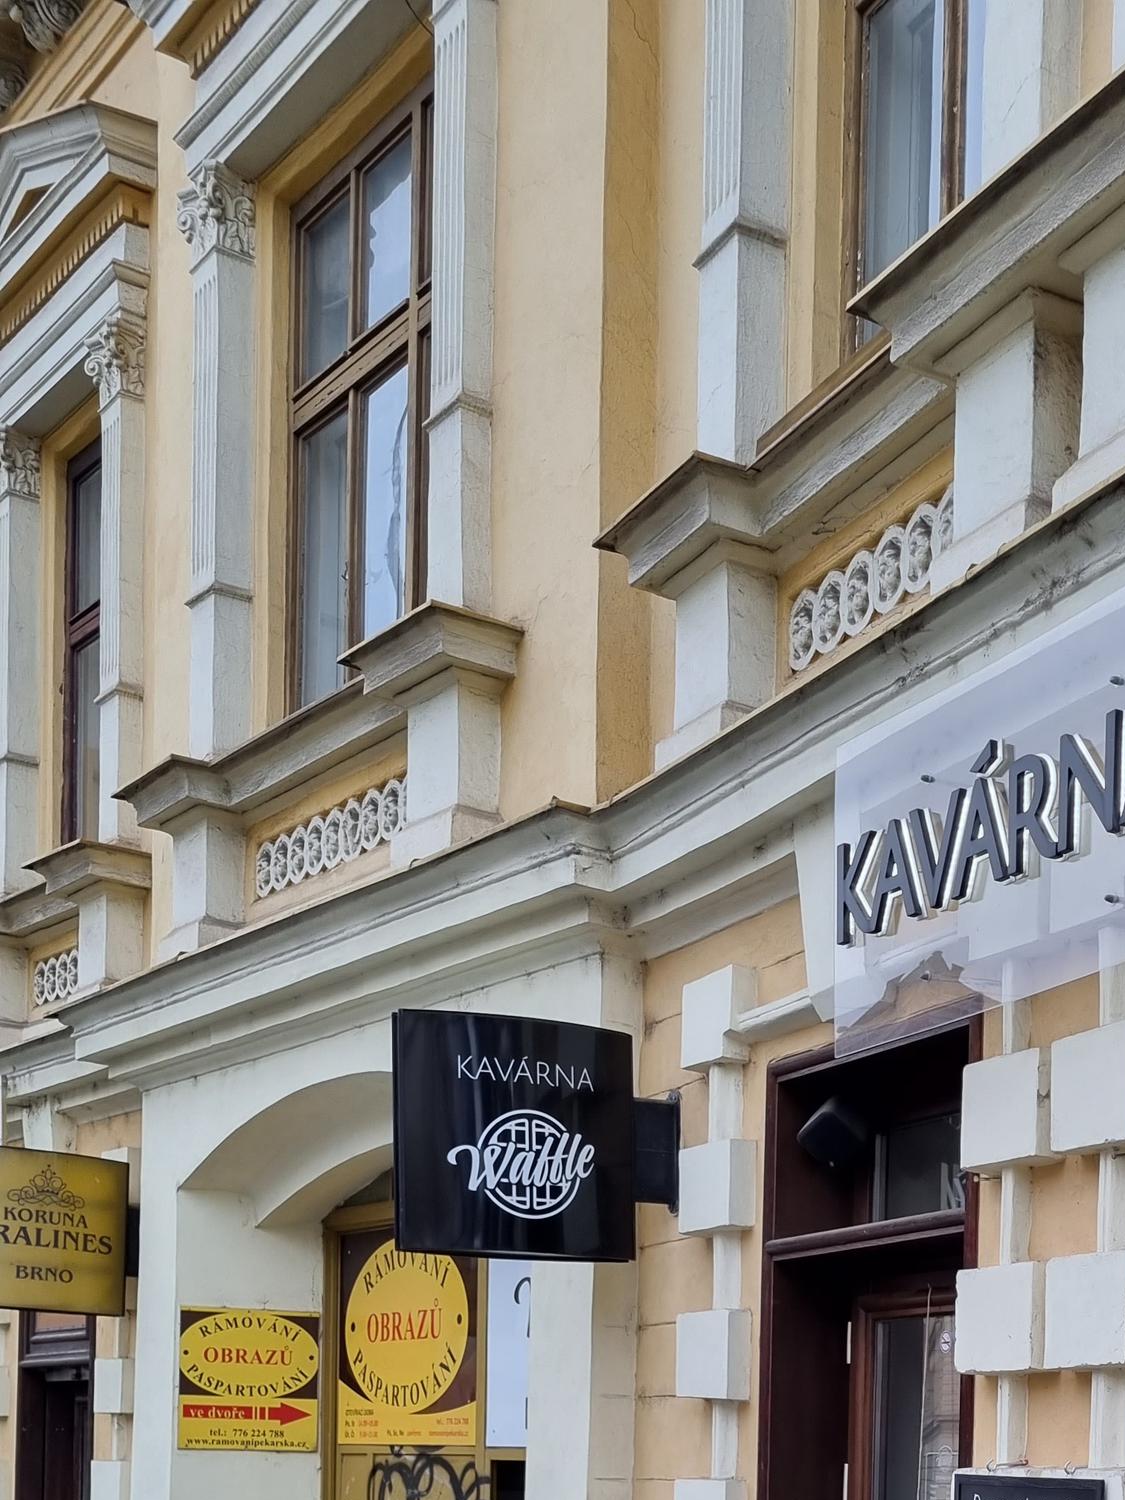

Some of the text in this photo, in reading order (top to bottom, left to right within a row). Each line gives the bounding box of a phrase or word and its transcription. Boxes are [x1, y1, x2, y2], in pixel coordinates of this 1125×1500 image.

[457, 1054, 594, 1092] KAVÁRNA
[447, 1132, 595, 1191] Waffle
[3, 1206, 88, 1229] KORUNA
[15, 1264, 74, 1283] BRNO
[198, 1309, 302, 1342] RÁMOVÁNÍ
[366, 1297, 443, 1343] OBRAZŮ
[203, 1345, 293, 1367] OBRAZŮ
[186, 1364, 309, 1397] PASPARTOVÁNÍ
[352, 1341, 458, 1408] PASPARTOVÁNÍ
[189, 1406, 246, 1420] ve dvoře
[209, 1428, 285, 1438] tel.: 776 224 788
